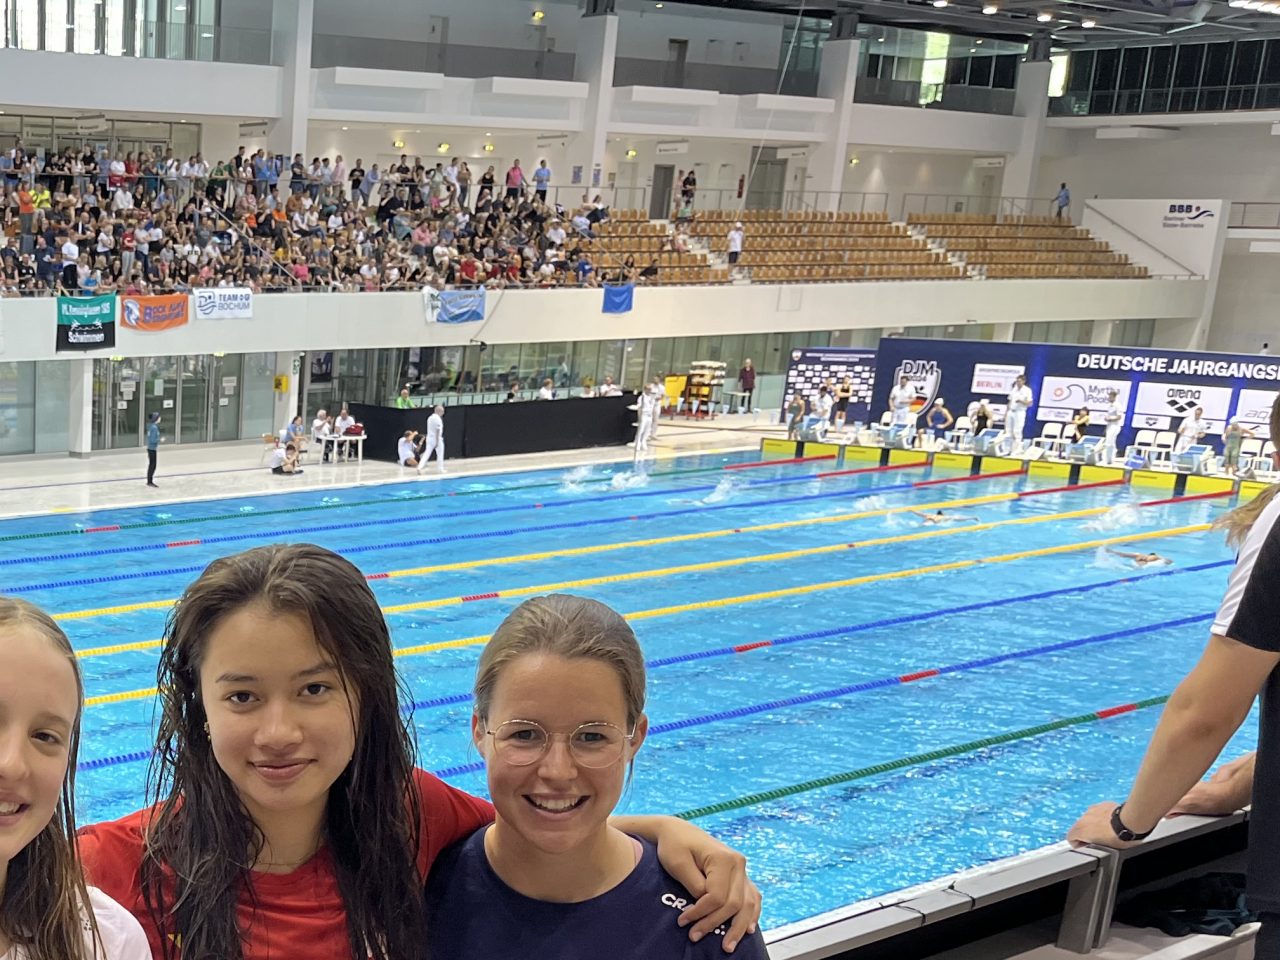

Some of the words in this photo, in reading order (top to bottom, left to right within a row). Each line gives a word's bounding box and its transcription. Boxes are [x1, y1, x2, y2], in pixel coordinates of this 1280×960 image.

[1169, 204, 1193, 213] BBB
[903, 361, 935, 376] DJM
[1077, 353, 1168, 373] DEUTSCHE
[1167, 359, 1280, 381] JAHRGANGS
[1167, 388, 1201, 400] arena
